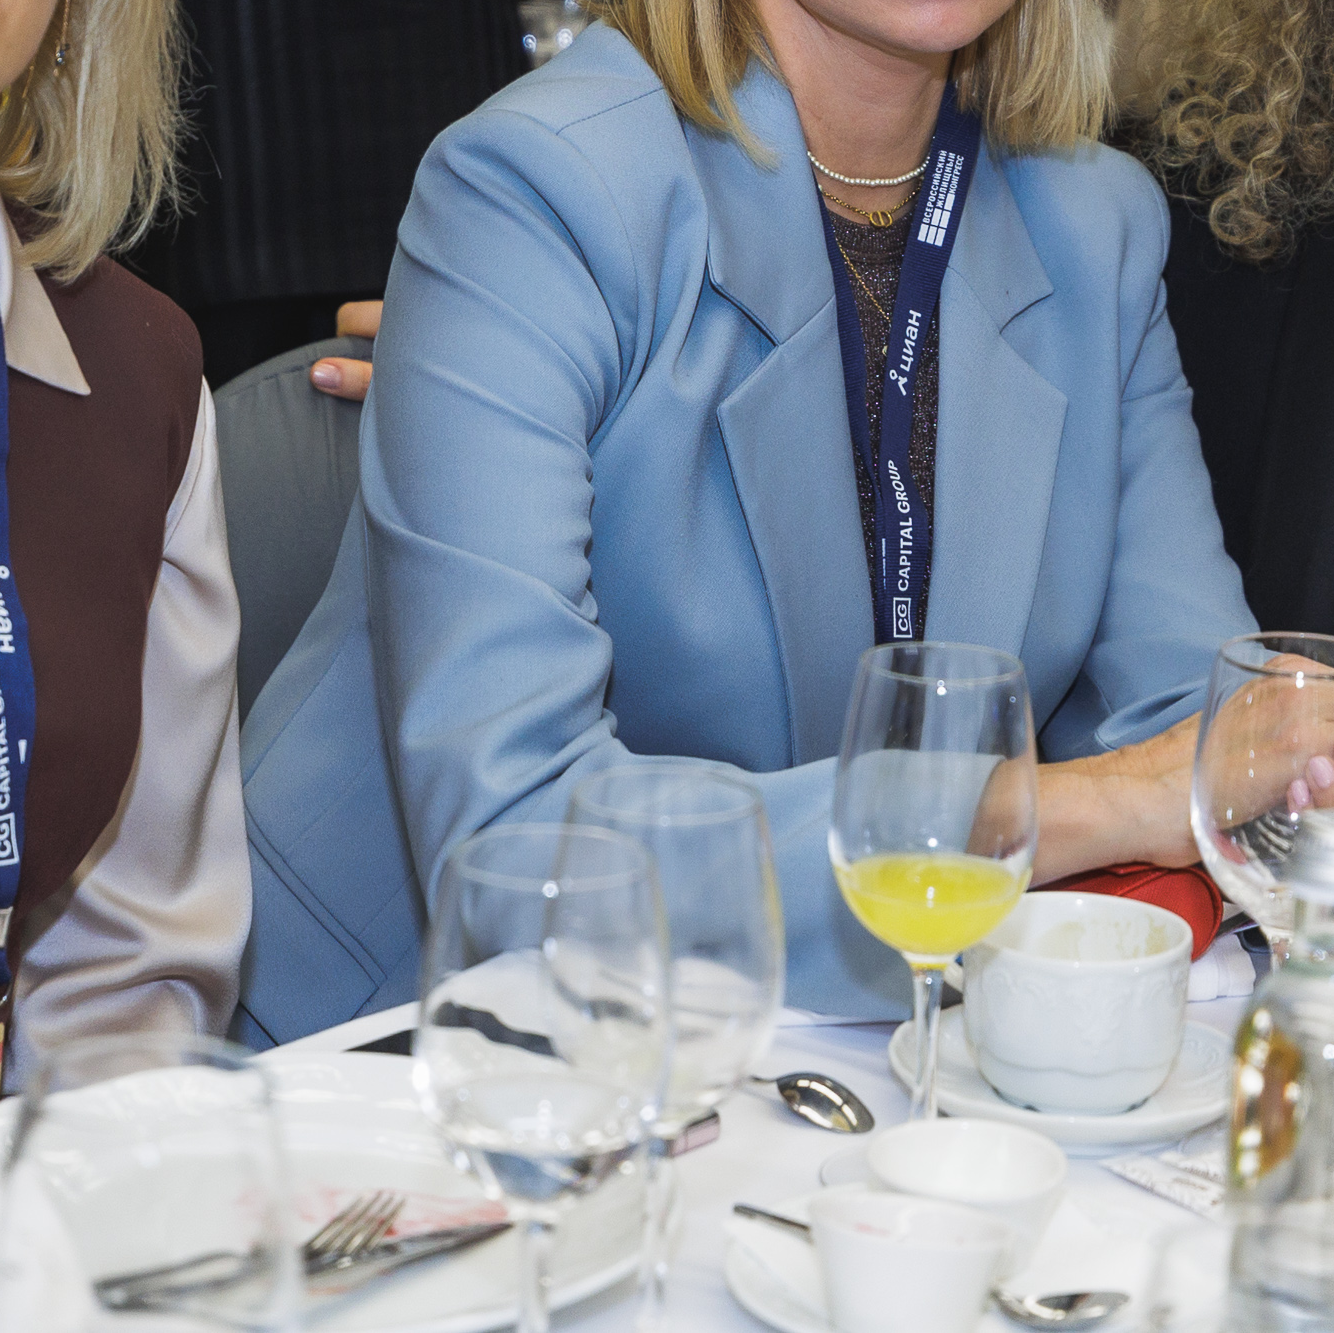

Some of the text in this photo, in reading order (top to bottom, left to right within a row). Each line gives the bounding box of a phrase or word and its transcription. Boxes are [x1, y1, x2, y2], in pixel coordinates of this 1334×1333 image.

[922, 149, 948, 224] ВСЕРОССИЙСКИЙ
[935, 152, 956, 208] ЖИЛИЩНЫЙ
[948, 154, 965, 194] КОНГРЕСС
[899, 309, 922, 372] циан
[887, 459, 911, 514] GROUP
[897, 517, 913, 592] CAPITAL
